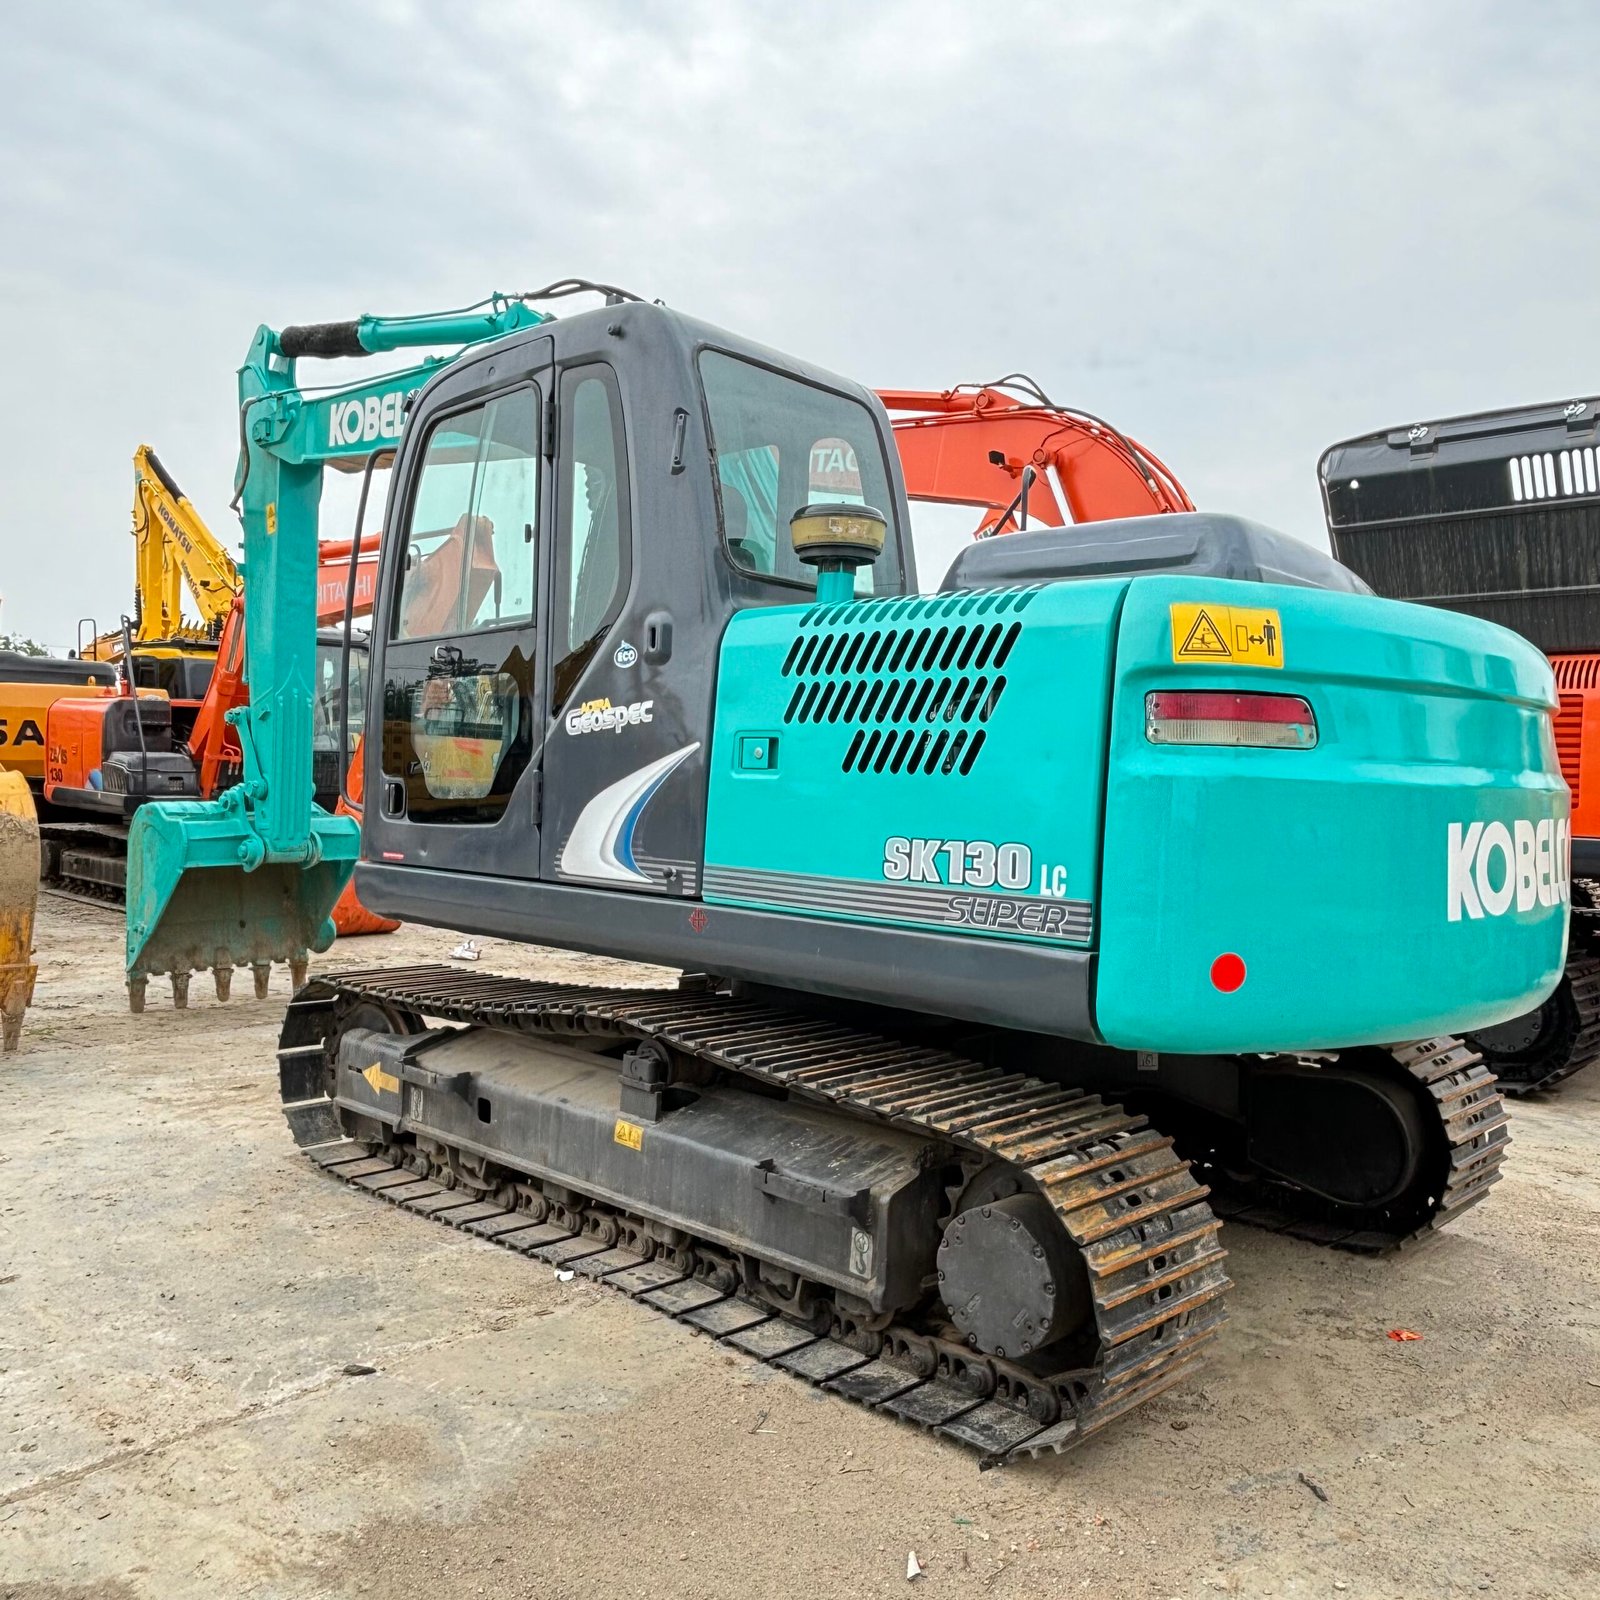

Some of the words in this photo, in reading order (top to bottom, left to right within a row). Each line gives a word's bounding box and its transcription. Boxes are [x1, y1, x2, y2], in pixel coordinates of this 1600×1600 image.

[158, 502, 192, 554] KOMATSU
[317, 575, 371, 605] HITAHI
[49, 767, 63, 782] 130
[883, 835, 1032, 890] SK130
[1039, 863, 1068, 897] LC
[944, 896, 1069, 935] SUPER
